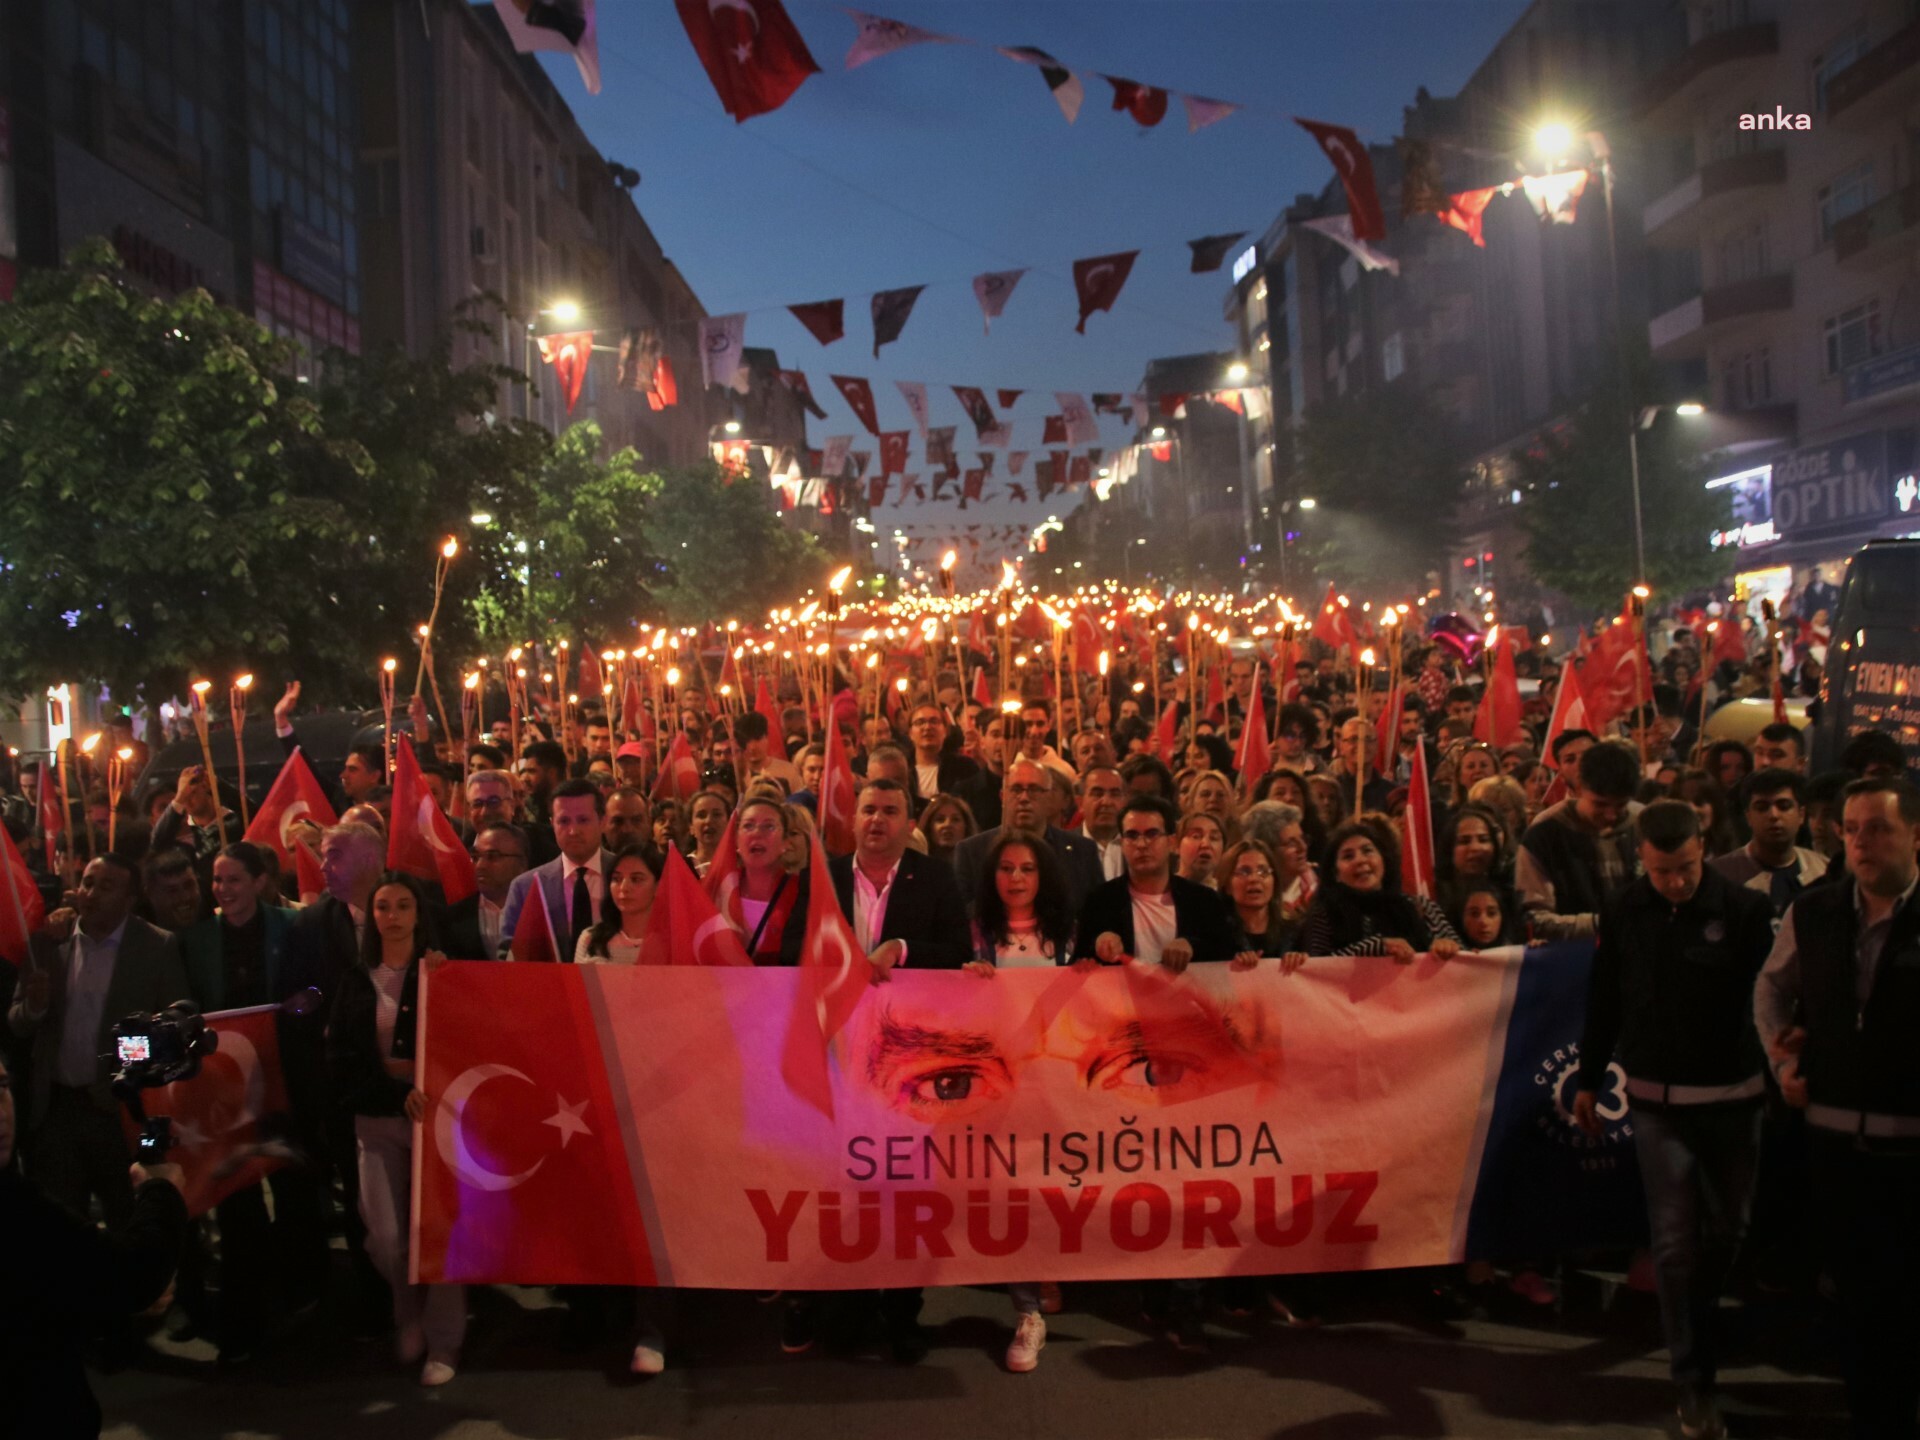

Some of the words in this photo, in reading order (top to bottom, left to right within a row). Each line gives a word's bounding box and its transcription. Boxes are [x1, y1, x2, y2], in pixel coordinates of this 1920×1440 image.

[1773, 449, 1882, 529] OPTİK
[1775, 451, 1830, 486] GÖZDE
[846, 1125, 1017, 1181] SENİN
[1042, 1115, 1283, 1187] IŞIĞINDA
[744, 1170, 1379, 1263] YÜRÜYORUZ
